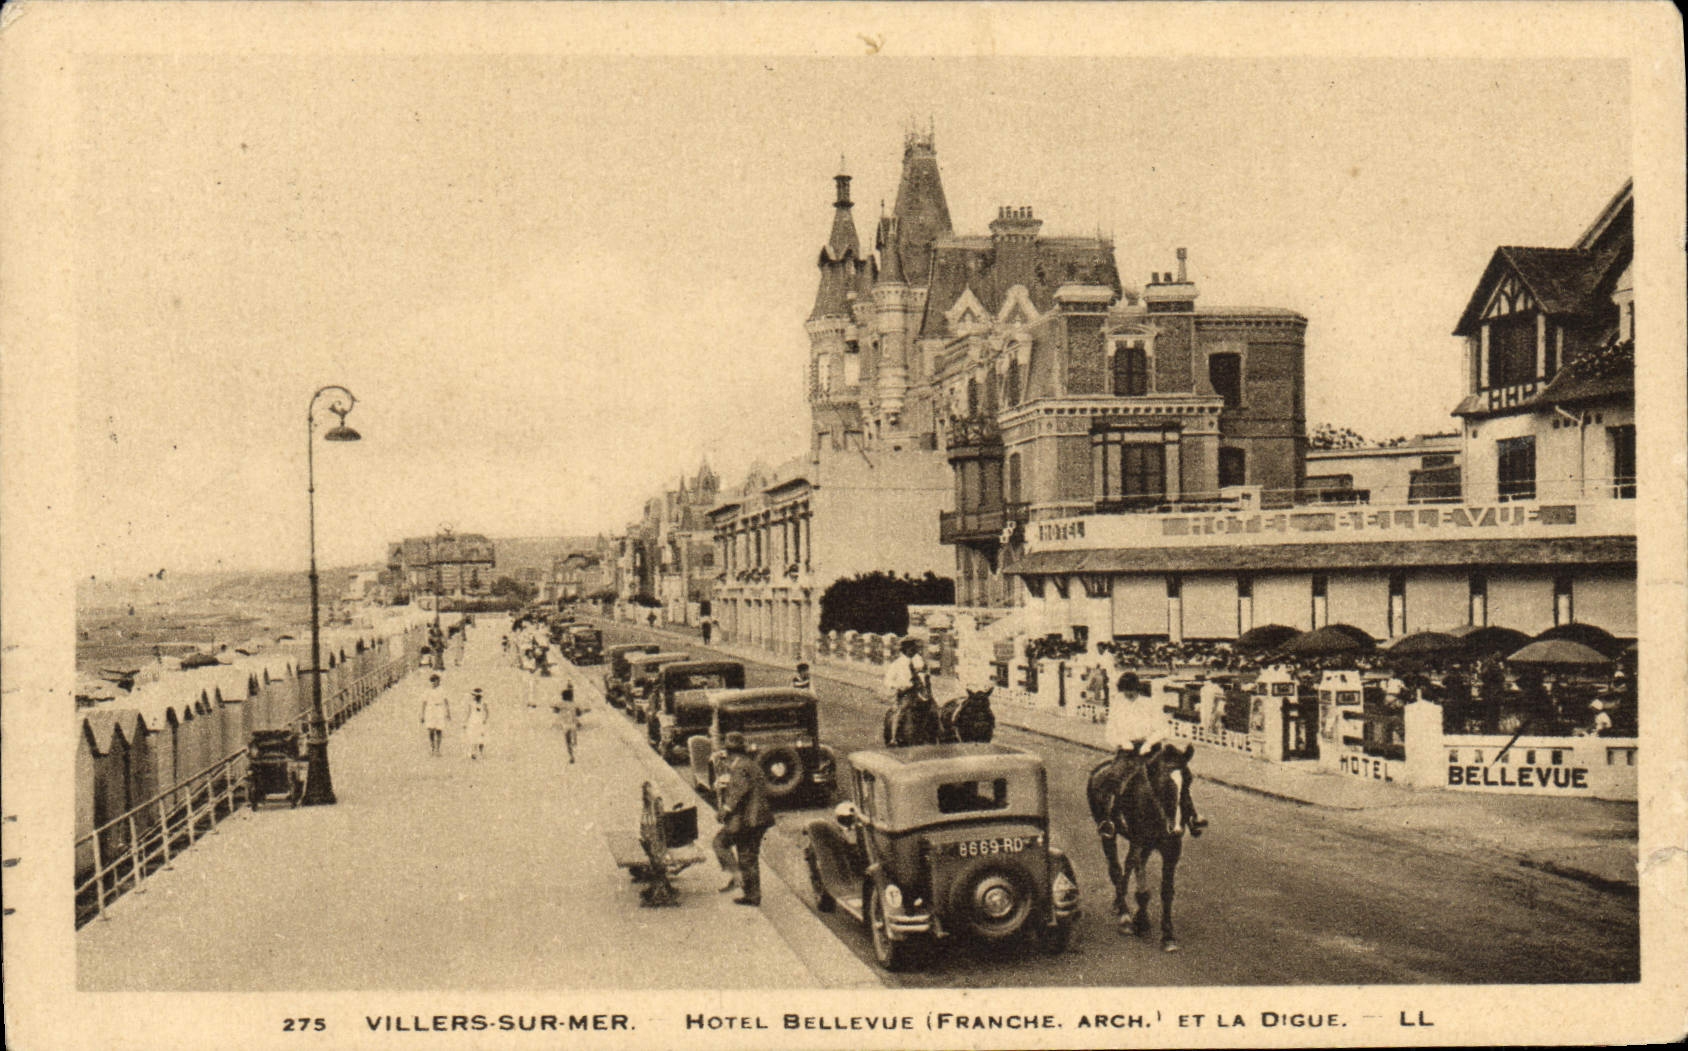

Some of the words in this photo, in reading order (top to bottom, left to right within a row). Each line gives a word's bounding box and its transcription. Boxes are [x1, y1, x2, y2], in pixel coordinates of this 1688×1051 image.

[1038, 521, 1086, 541] HOTEL
[1187, 514, 1300, 535] HOTEL
[1334, 508, 1540, 529] BELLEVUE
[1340, 754, 1393, 783] HOTEL
[1448, 766, 1588, 789] BELLEVUE
